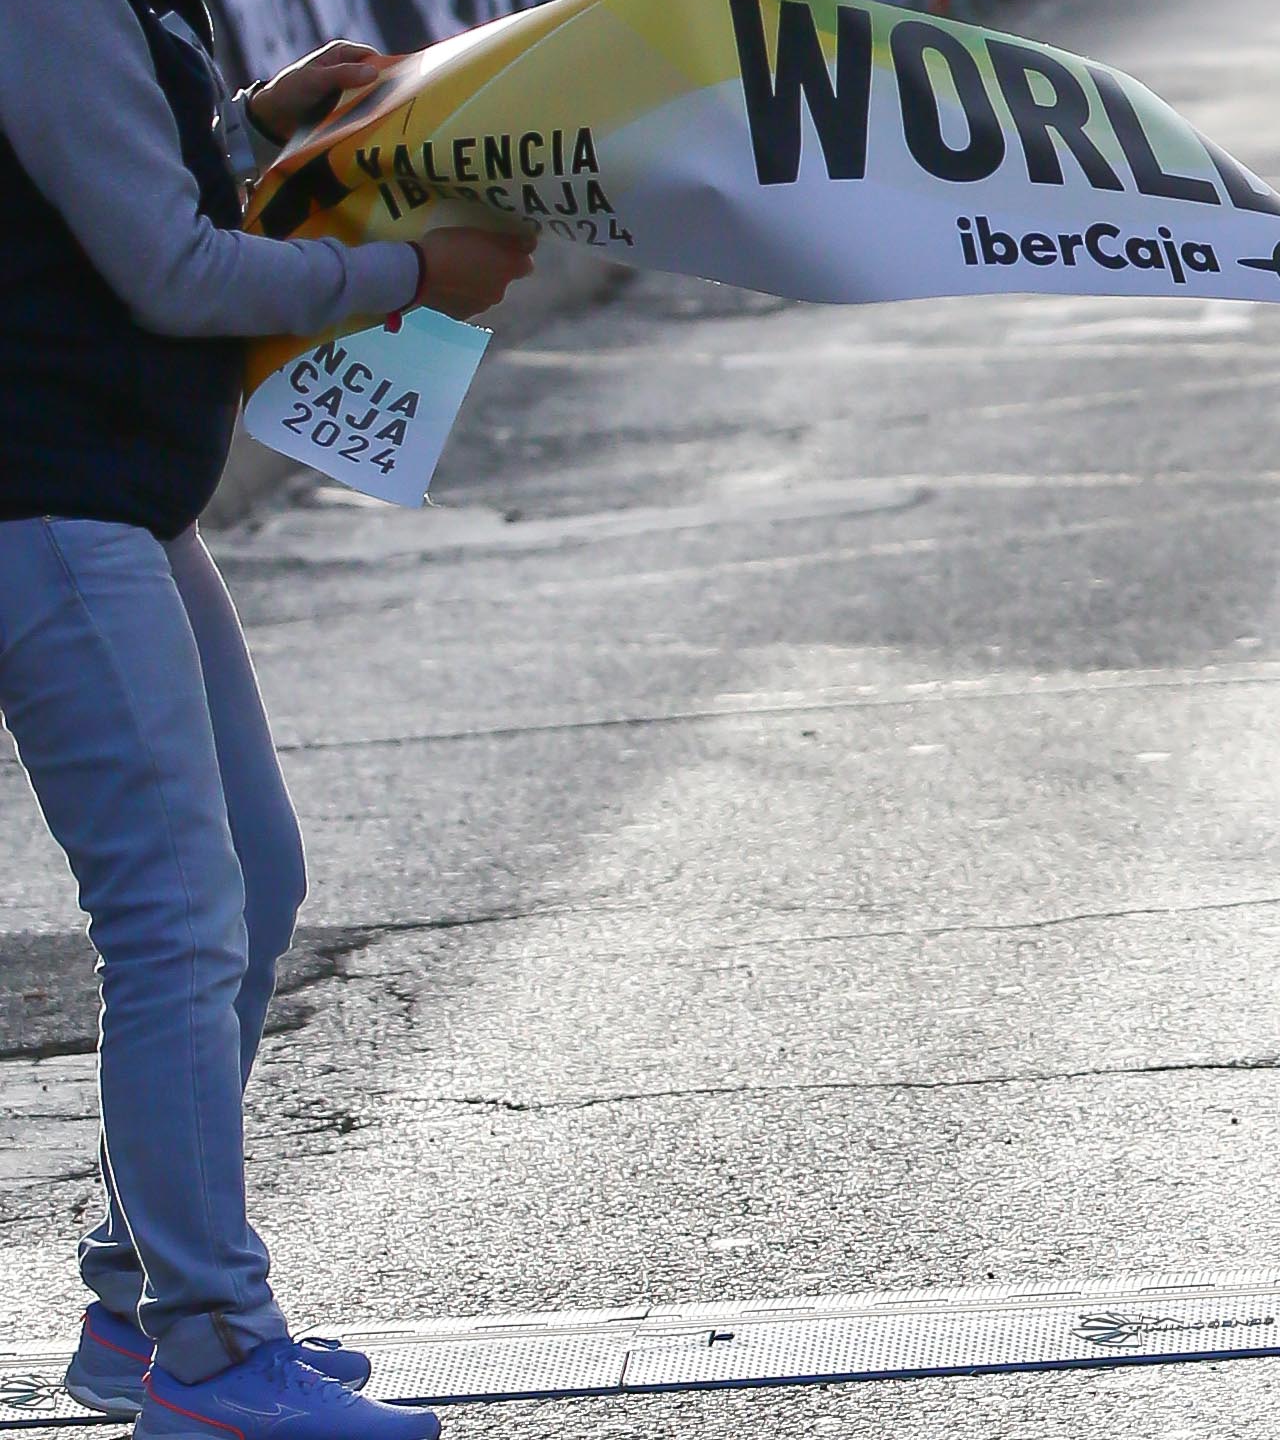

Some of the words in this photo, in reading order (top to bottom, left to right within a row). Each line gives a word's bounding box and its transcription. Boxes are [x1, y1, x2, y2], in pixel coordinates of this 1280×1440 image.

[356, 127, 599, 182] VALENCIA
[956, 215, 1221, 284] iberCaja
[280, 360, 407, 446] CAJA
[281, 402, 396, 474] 2024
